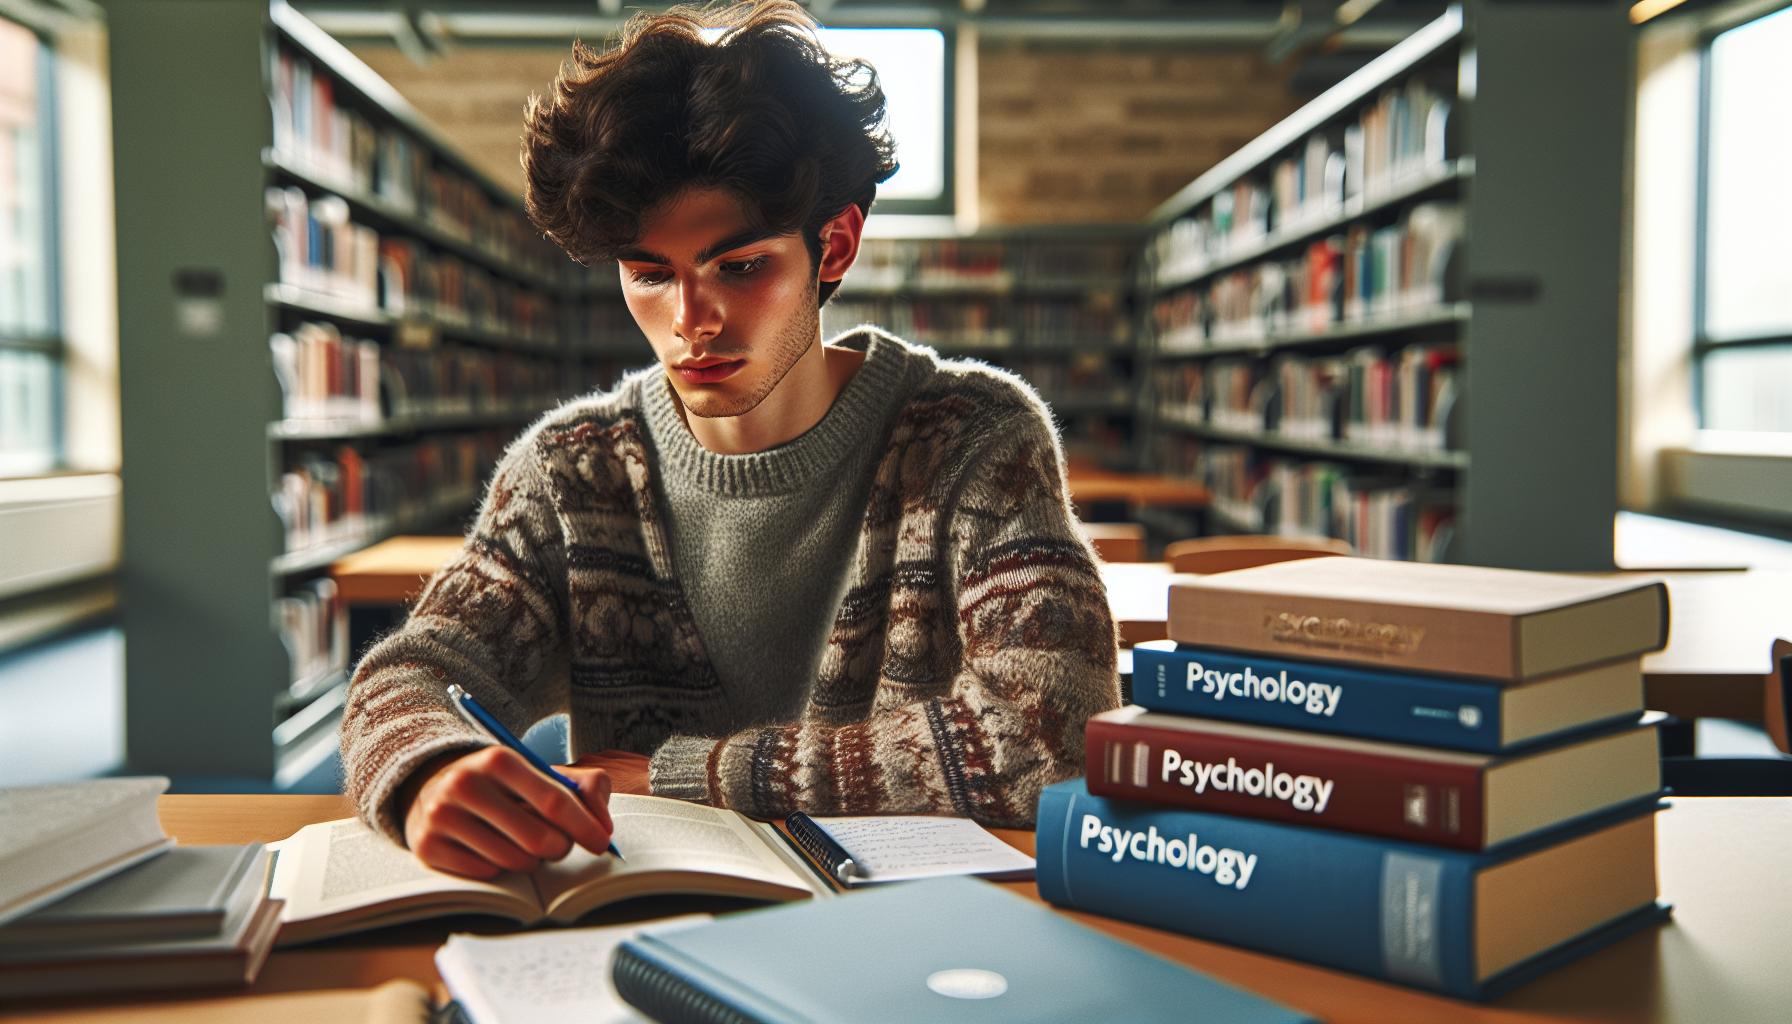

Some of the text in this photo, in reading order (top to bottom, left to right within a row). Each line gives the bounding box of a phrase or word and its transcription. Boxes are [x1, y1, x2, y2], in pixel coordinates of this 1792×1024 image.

[1186, 661, 1342, 716] Psychology
[1162, 749, 1334, 813] Psychology
[1080, 814, 1258, 890] Psychology
